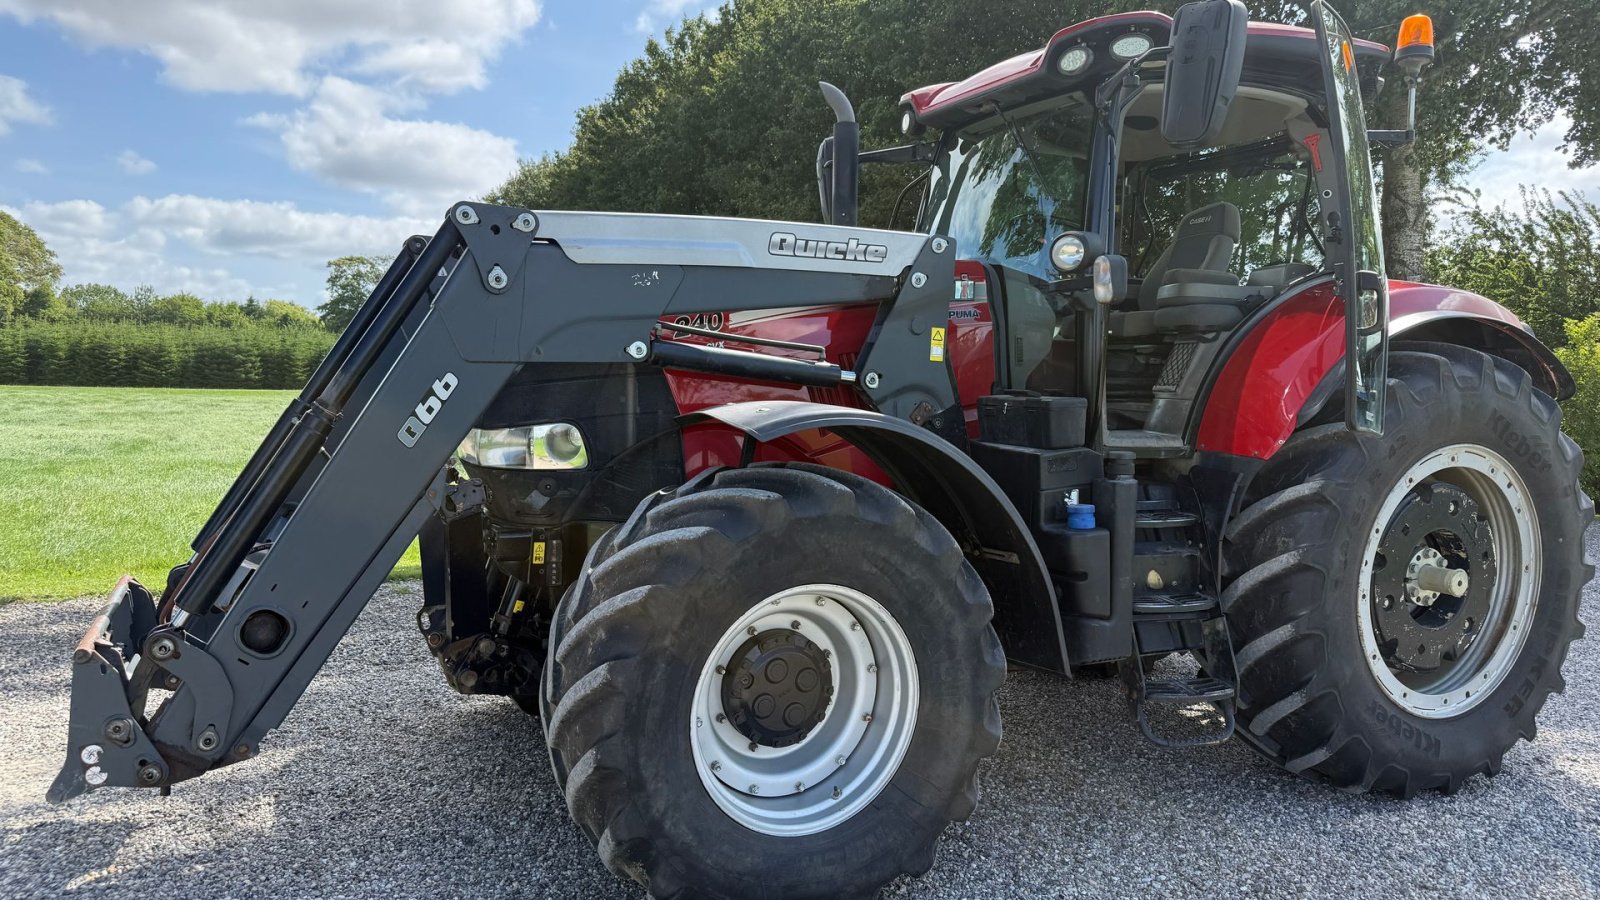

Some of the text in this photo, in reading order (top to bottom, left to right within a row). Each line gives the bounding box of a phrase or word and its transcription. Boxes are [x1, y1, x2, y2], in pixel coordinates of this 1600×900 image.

[768, 232, 888, 263] Quicke
[673, 312, 724, 340] 240
[948, 310, 979, 319] PUMA
[397, 372, 459, 448] Q66
[1484, 407, 1552, 474] Kleber
